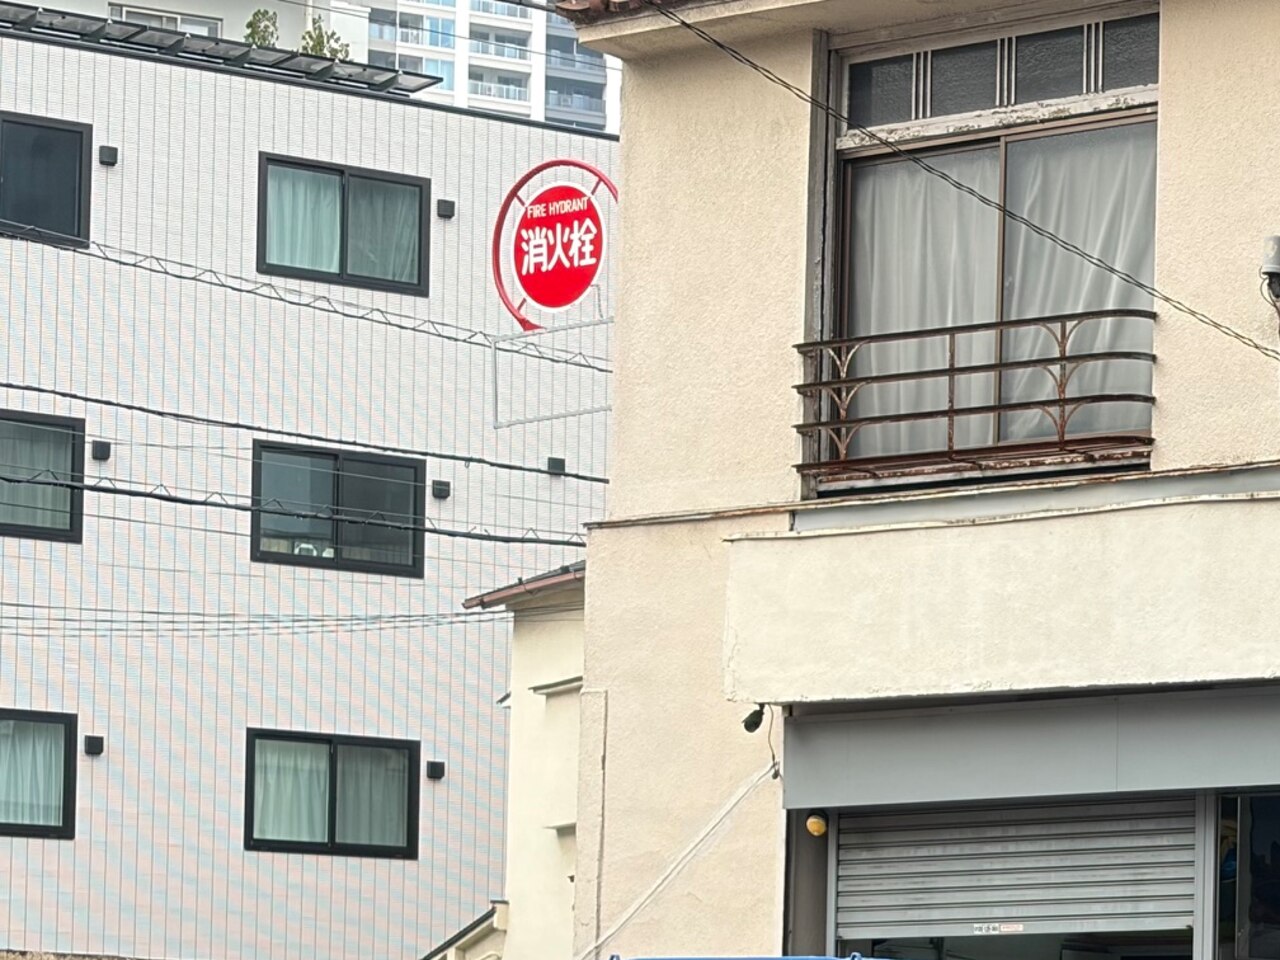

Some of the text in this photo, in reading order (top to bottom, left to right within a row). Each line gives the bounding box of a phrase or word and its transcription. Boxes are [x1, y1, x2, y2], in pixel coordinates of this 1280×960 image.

[527, 197, 589, 218] FIRE HYDRANT
[521, 218, 597, 275] 消火栓
